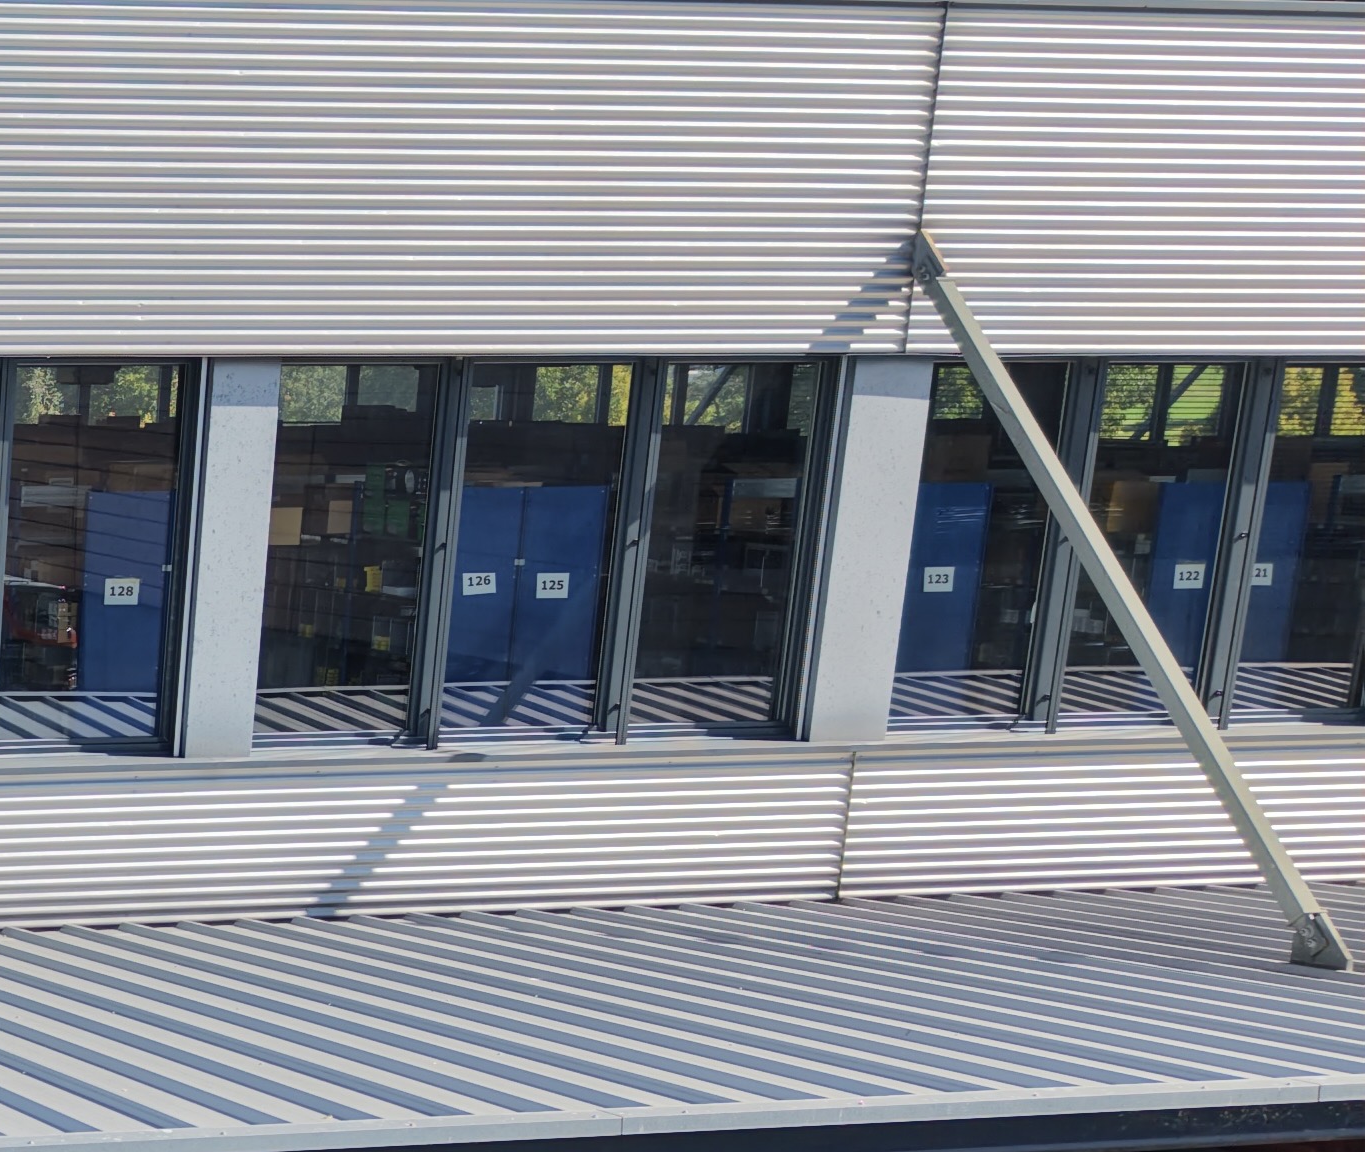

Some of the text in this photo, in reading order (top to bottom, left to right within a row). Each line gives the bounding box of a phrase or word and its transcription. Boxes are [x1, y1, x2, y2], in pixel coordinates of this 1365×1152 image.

[1179, 570, 1200, 581] 122
[1254, 567, 1268, 578] 21
[467, 575, 491, 587] 126
[927, 573, 949, 584] 123
[541, 580, 564, 590] 125
[109, 586, 134, 597] 128
